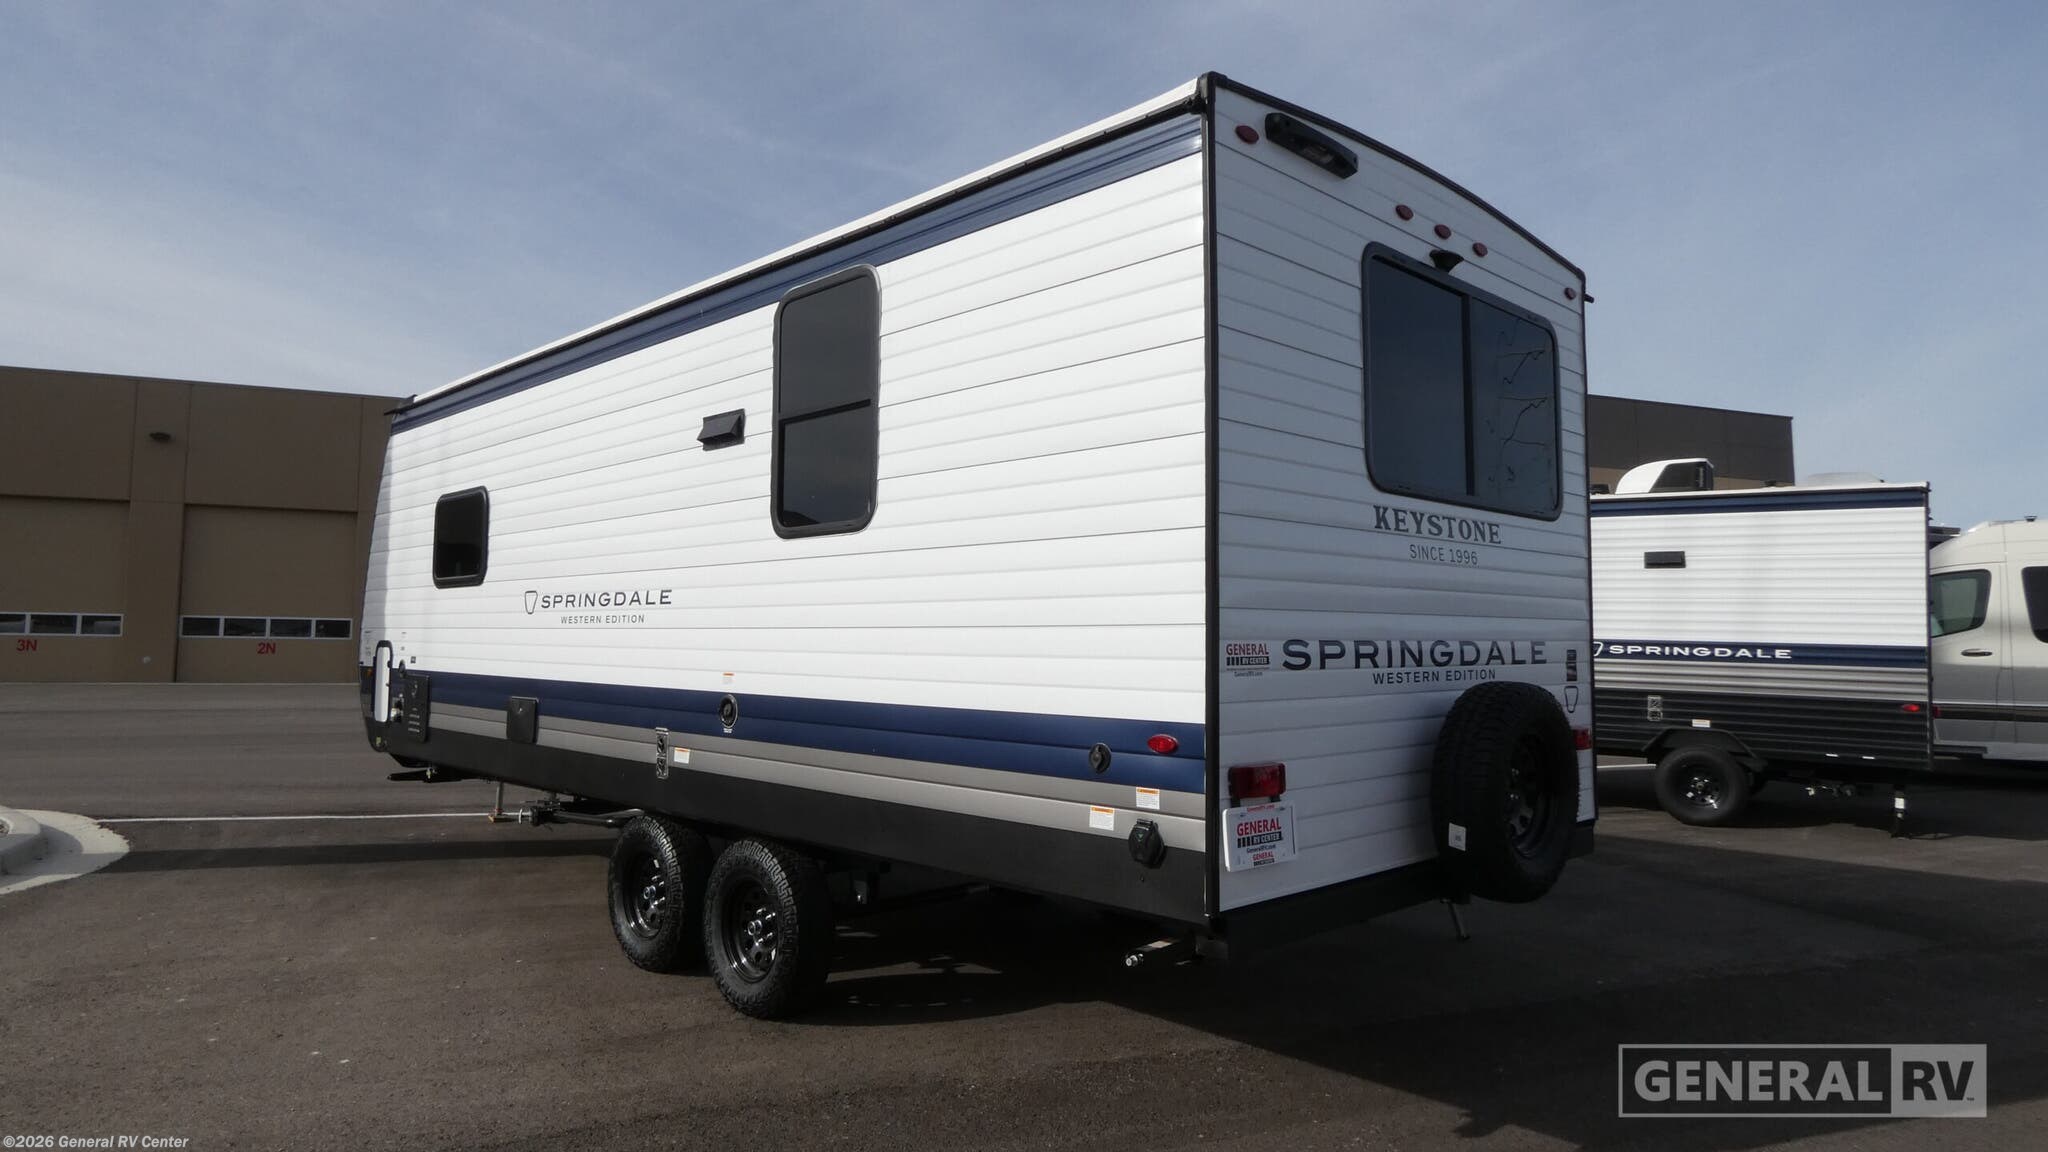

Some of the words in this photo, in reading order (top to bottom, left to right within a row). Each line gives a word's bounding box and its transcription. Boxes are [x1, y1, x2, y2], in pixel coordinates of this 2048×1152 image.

[1373, 505, 1502, 544] KEYSTONE
[1409, 544, 1446, 562] SINCE
[1449, 548, 1479, 566] 1996
[541, 589, 673, 609] SPRINGDALE
[560, 615, 602, 625] WESTERN
[606, 614, 645, 624] EDITION
[16, 639, 38, 652] 3N
[257, 642, 276, 655] 2N
[1226, 643, 1269, 656] GENERAL
[1609, 645, 1793, 660] SPRINGDALE
[1282, 639, 1548, 670] SPRINGDALE
[1373, 671, 1441, 685] WESTERN
[1446, 669, 1496, 682] EDITION
[1237, 817, 1282, 836] GENERAL
[1262, 833, 1281, 842] CENTER
[1253, 851, 1274, 861] GENERAL
